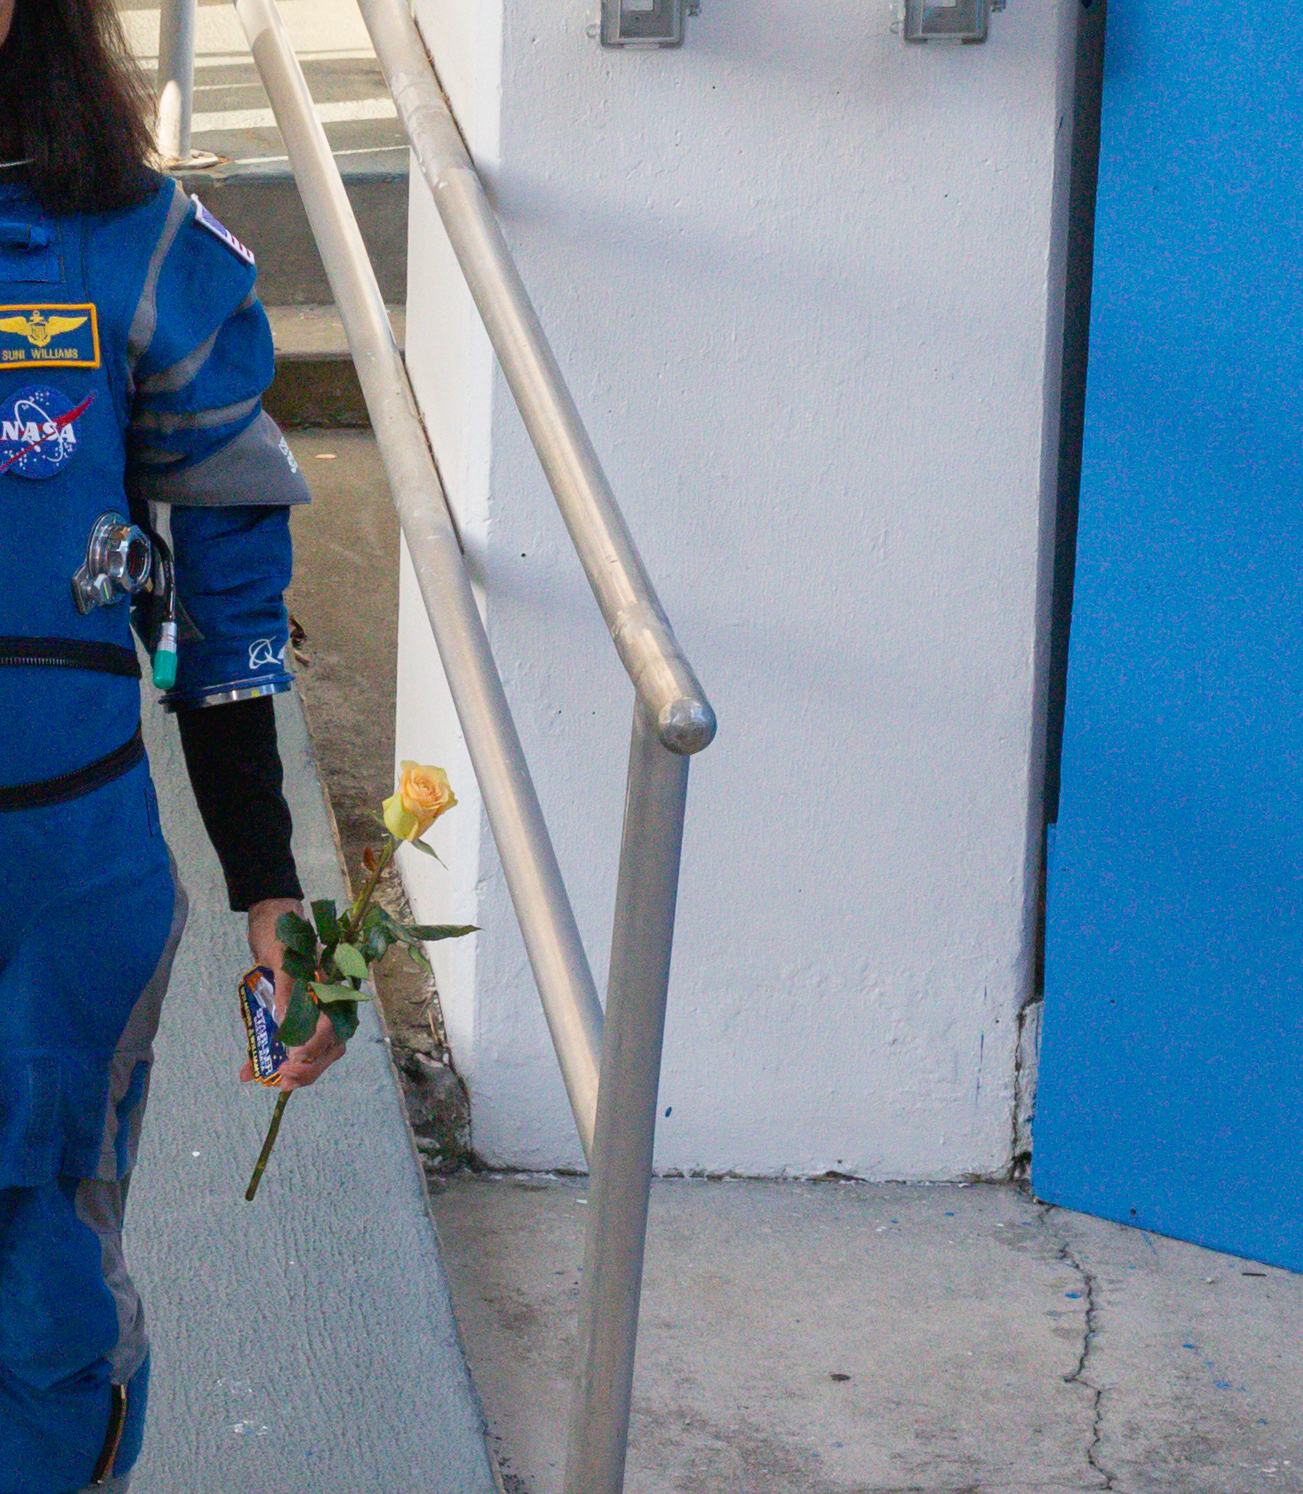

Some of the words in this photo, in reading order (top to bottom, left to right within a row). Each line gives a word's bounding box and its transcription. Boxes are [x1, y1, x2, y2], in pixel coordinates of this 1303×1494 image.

[2, 349, 26, 361] SUNI
[30, 348, 79, 360] WILLIAMS
[1, 421, 77, 443] NASA
